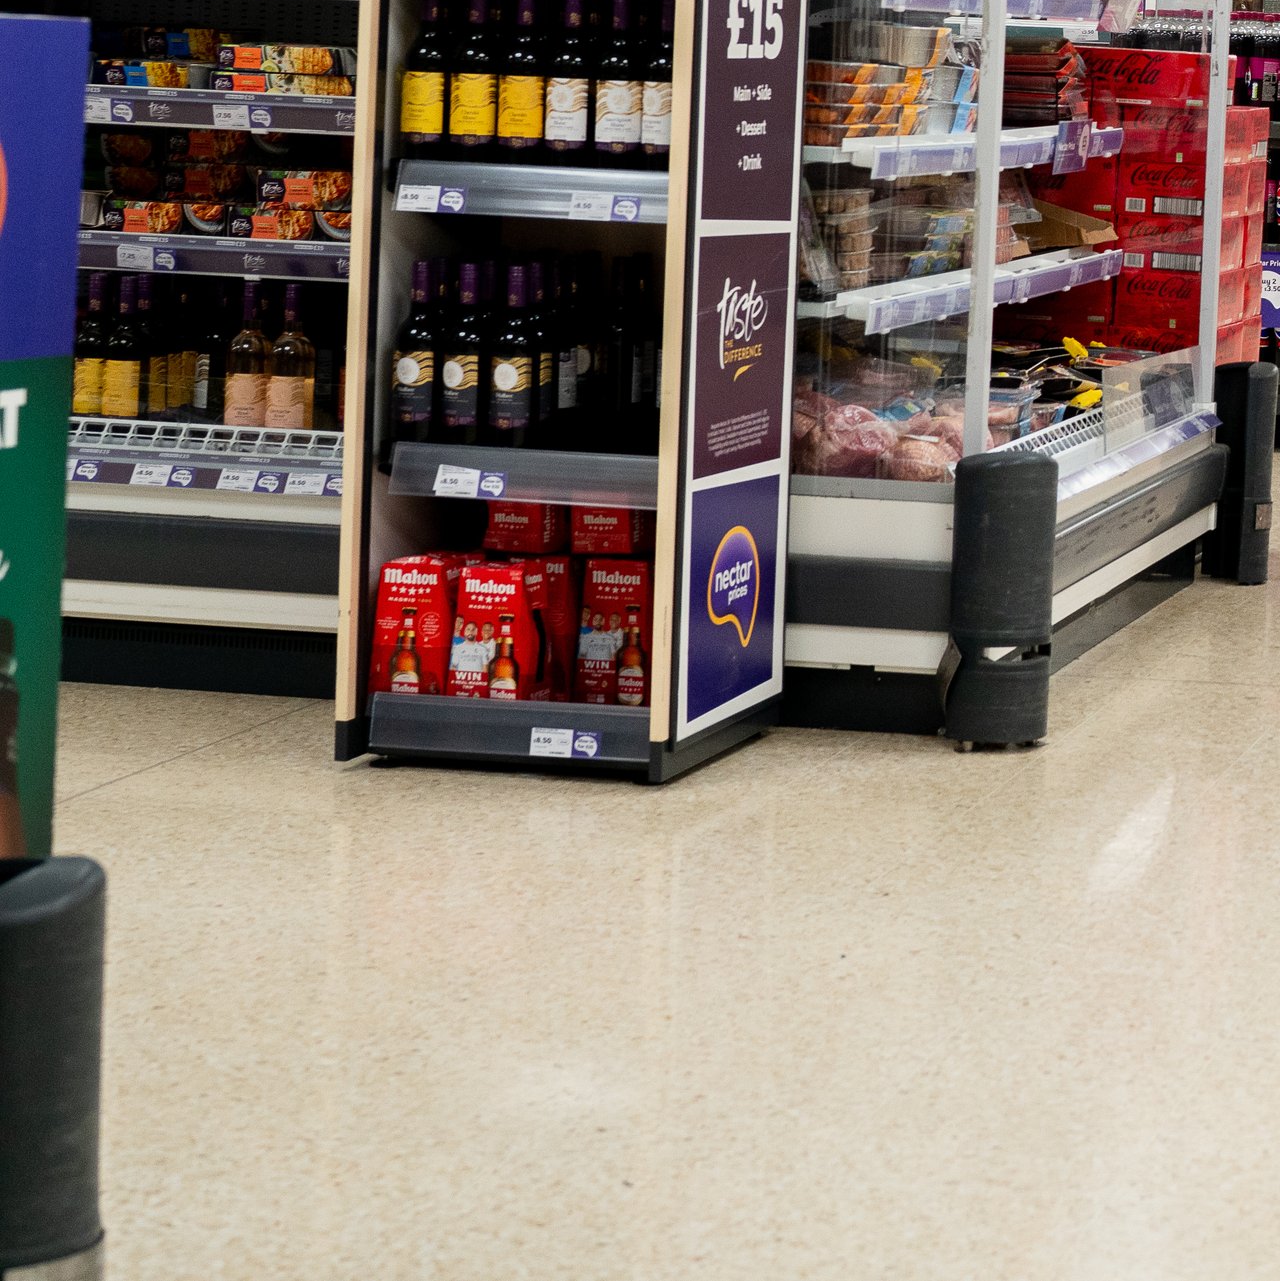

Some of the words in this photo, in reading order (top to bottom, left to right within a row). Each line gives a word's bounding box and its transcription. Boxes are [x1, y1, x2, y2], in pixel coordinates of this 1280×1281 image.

[733, 84, 752, 102] Main
[756, 84, 772, 102] Side
[741, 120, 766, 136] Dessert
[742, 153, 762, 171] Drink
[716, 276, 768, 370] taste
[724, 339, 734, 350] THE
[724, 342, 763, 366] DIFFERENCE
[494, 512, 528, 524] Mahou
[583, 514, 618, 526] Mahou
[384, 568, 438, 586] Mahou
[592, 570, 641, 586] Mahou
[714, 558, 754, 593] nectar
[465, 579, 516, 596] Mahou
[727, 584, 748, 606] prices
[584, 660, 610, 669] WIN
[455, 671, 482, 681] WIN
